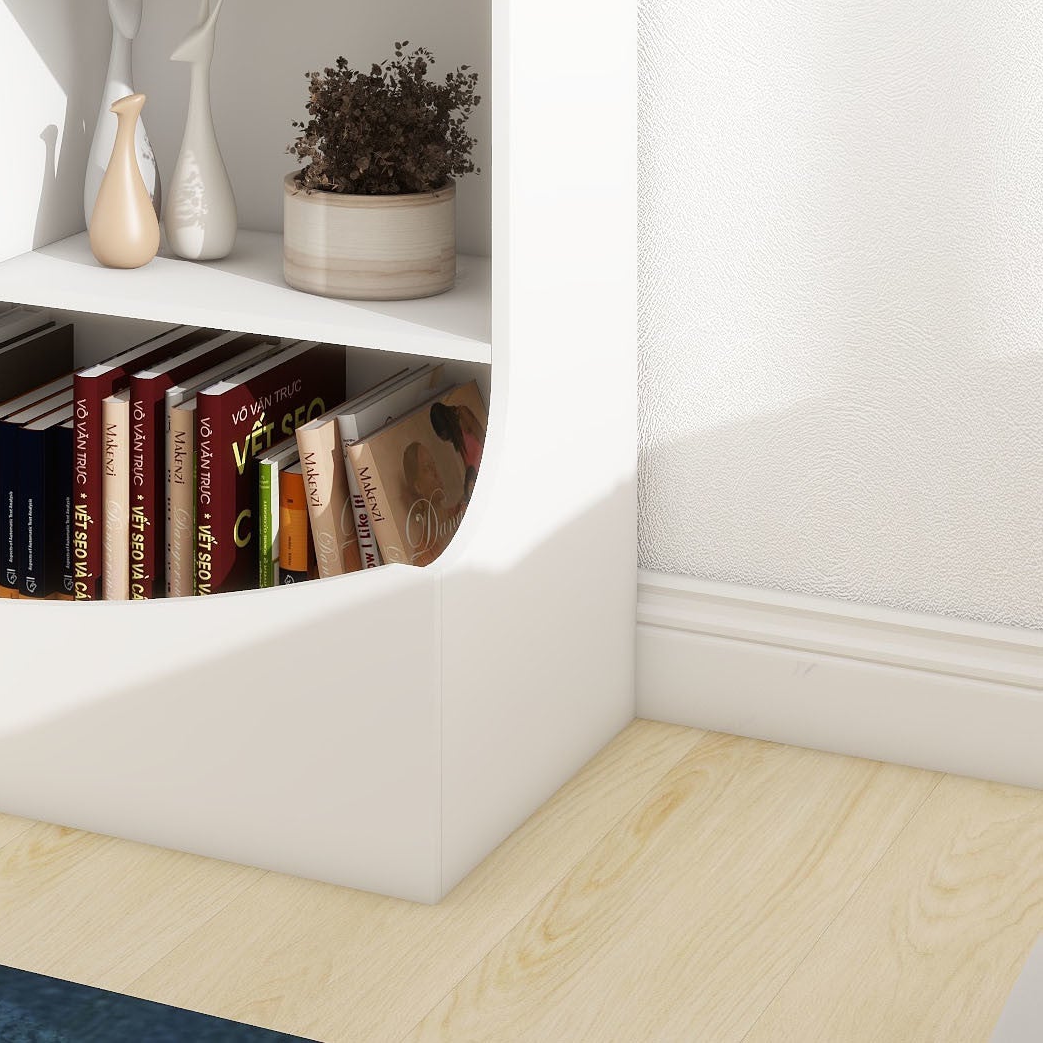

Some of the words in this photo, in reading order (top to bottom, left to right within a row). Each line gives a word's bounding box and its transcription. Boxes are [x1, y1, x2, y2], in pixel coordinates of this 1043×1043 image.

[250, 396, 272, 416] VĂN
[232, 412, 275, 476] VẾT
[74, 505, 93, 531] VẾT
[131, 506, 151, 531] VẾT
[357, 513, 371, 538] Like
[198, 525, 218, 550] VẾT
